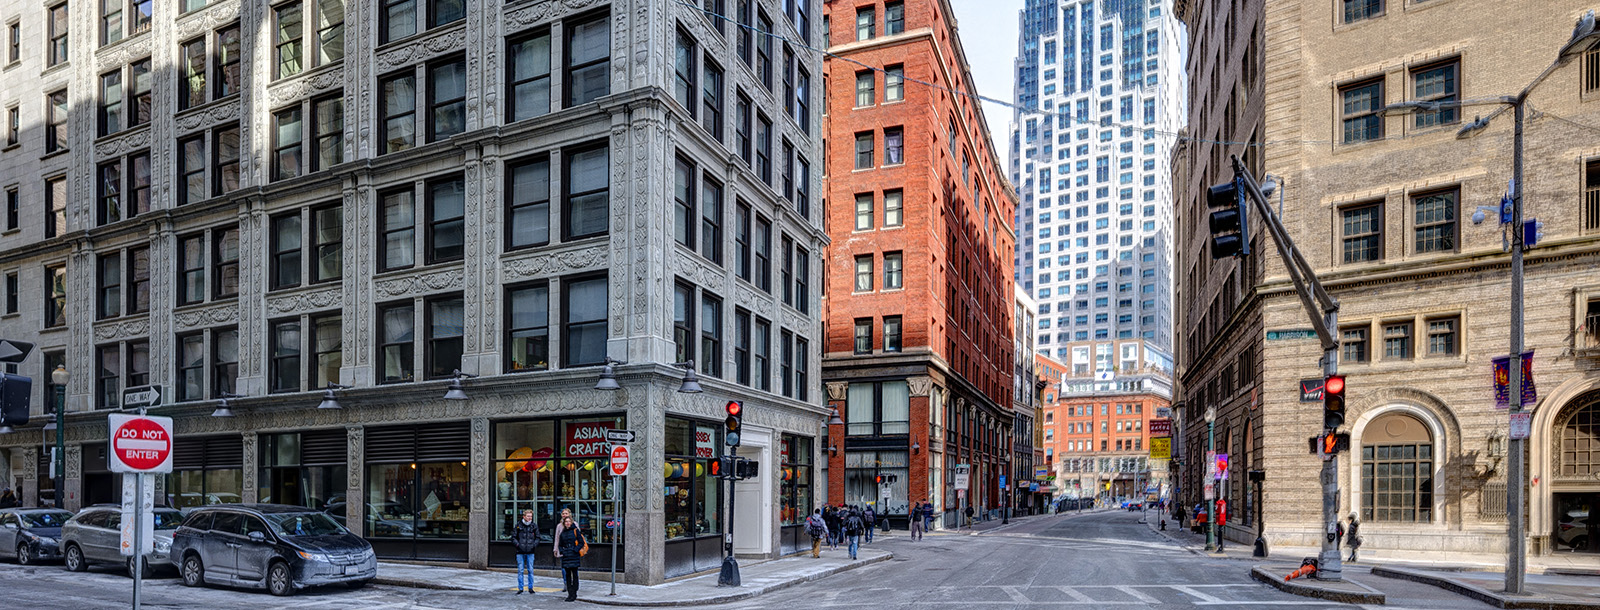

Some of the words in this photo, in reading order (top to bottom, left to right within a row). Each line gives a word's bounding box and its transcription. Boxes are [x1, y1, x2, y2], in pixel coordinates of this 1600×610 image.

[126, 394, 137, 403] ONE
[139, 392, 150, 401] WAY
[122, 429, 138, 438] DO
[142, 430, 163, 439] NOT
[573, 426, 607, 439] ASIAN
[569, 442, 612, 455] CRAFTS
[125, 450, 159, 459] ENTER
